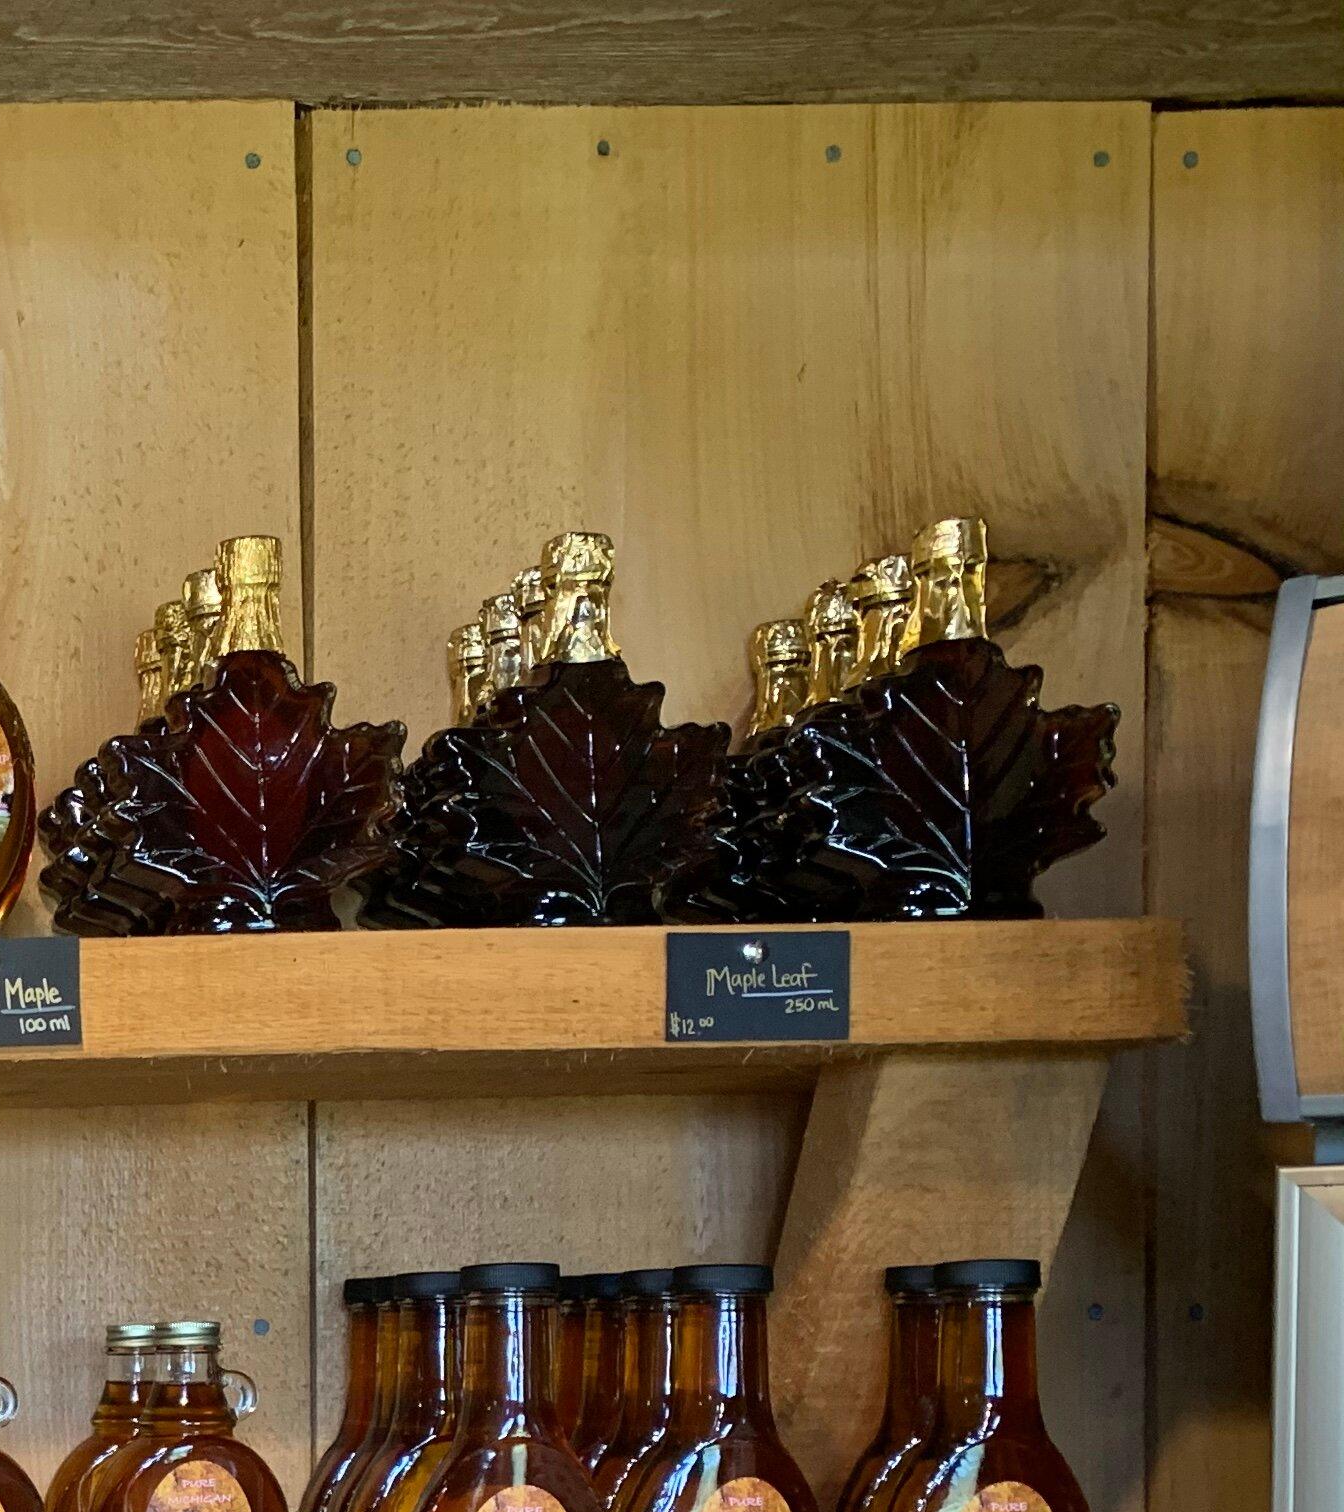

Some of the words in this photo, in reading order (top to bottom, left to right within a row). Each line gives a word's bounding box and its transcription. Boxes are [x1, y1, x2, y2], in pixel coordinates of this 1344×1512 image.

[706, 966, 766, 996] Maple
[772, 963, 818, 988] Leaf
[5, 977, 62, 1010] Maple
[785, 998, 814, 1013] 250
[19, 1018, 46, 1034] 100
